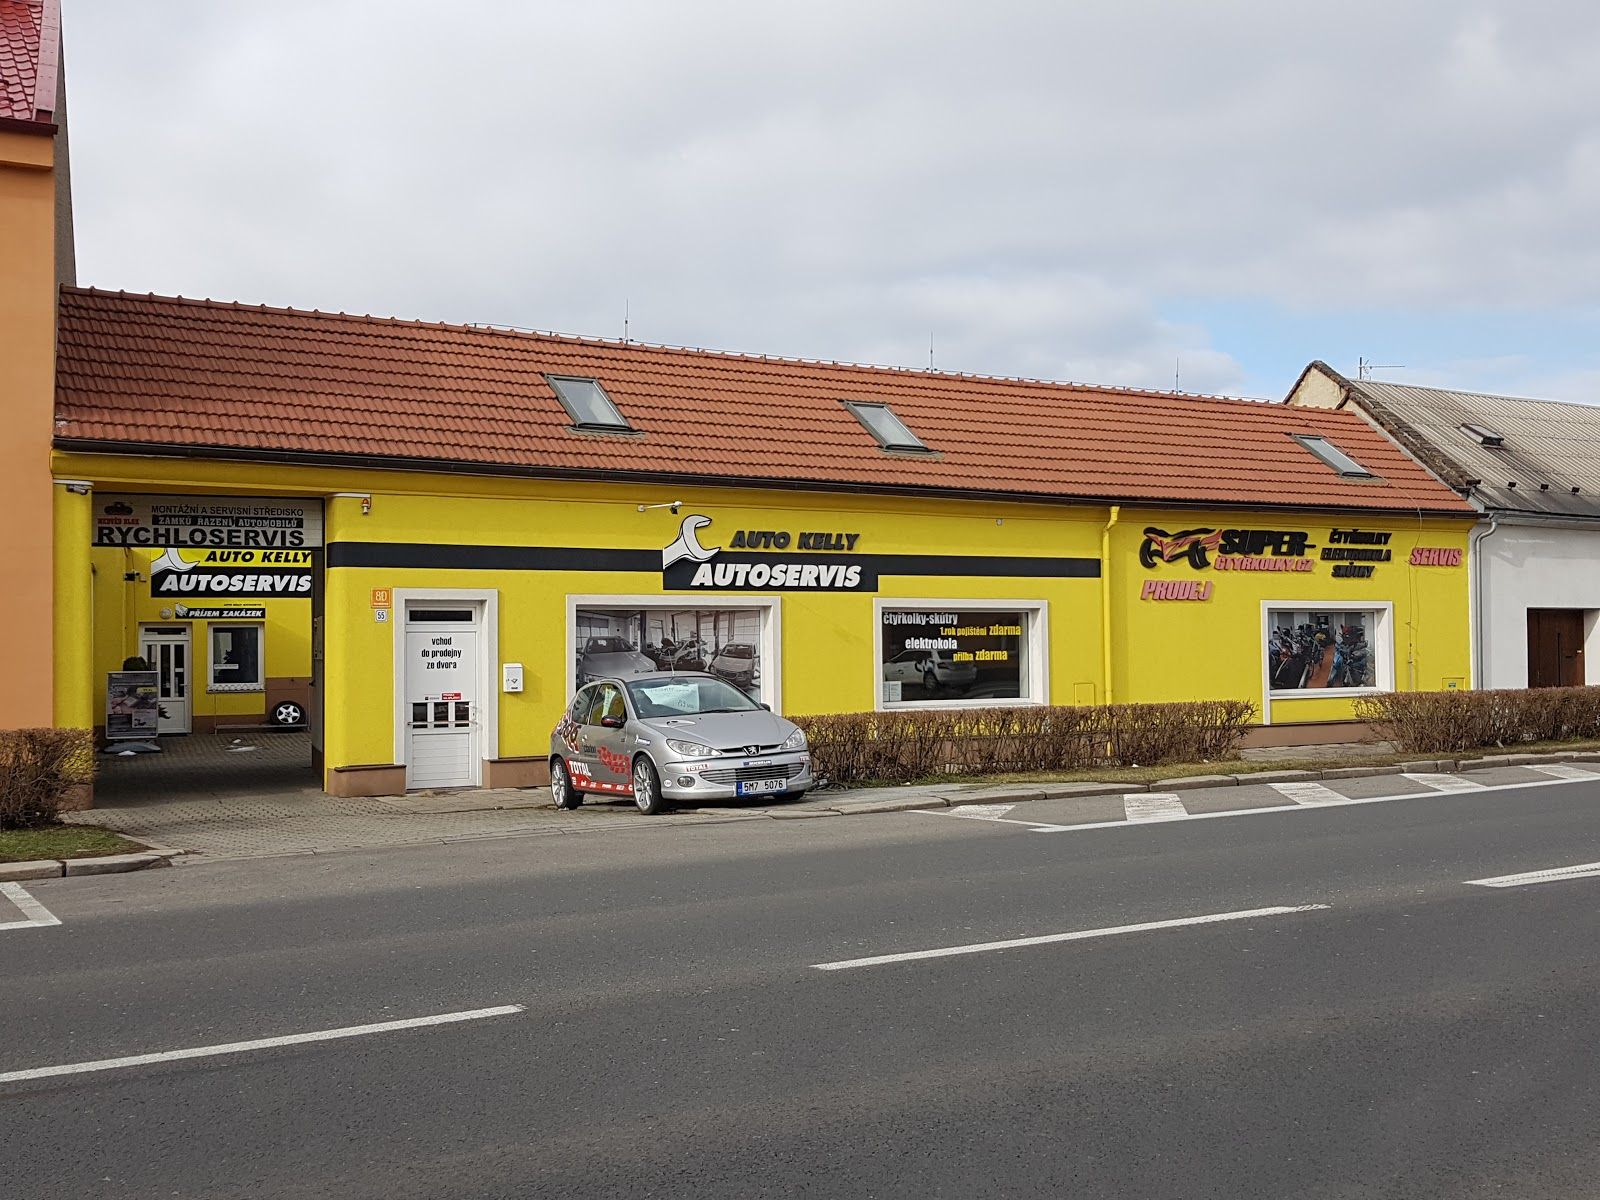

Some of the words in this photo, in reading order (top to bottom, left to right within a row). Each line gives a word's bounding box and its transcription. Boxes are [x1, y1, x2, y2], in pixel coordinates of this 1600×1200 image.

[151, 505, 199, 514] MONTÁŽNÍ
[201, 506, 208, 514] A
[210, 506, 251, 515] SERVISNÍ
[253, 507, 304, 516] STŘEDISKO
[158, 516, 192, 525] ZÁMKŮ
[238, 518, 298, 528] AUTOMOBILŮ
[97, 526, 305, 547] RYCHLOSERVIS
[730, 531, 790, 548] AUTO
[797, 532, 859, 550] KELLY
[204, 550, 255, 563] AUTO
[260, 550, 312, 563] KELLY
[1410, 548, 1462, 566] SERVIS
[690, 563, 862, 587] AUTOSERVIS
[159, 574, 312, 592] AUTOSERVIS
[1141, 580, 1213, 600] PRODEJ
[188, 609, 220, 617] PŘÍJEM
[221, 609, 262, 617] ZAKÁZEK
[377, 611, 385, 620] 55
[883, 613, 958, 625] čtyřkolky-skútry
[989, 624, 1022, 636] zdarma
[431, 636, 452, 646] vchod
[905, 637, 958, 650] elektrokola
[421, 648, 430, 658] do
[431, 648, 462, 659] prodejny
[975, 649, 1008, 661] zdarma
[426, 661, 435, 669] ze
[436, 659, 457, 670] dvora
[568, 760, 592, 777] TOTAL
[686, 763, 709, 772] TOTAL
[743, 781, 759, 793] 5M7
[764, 780, 783, 790] 5076
